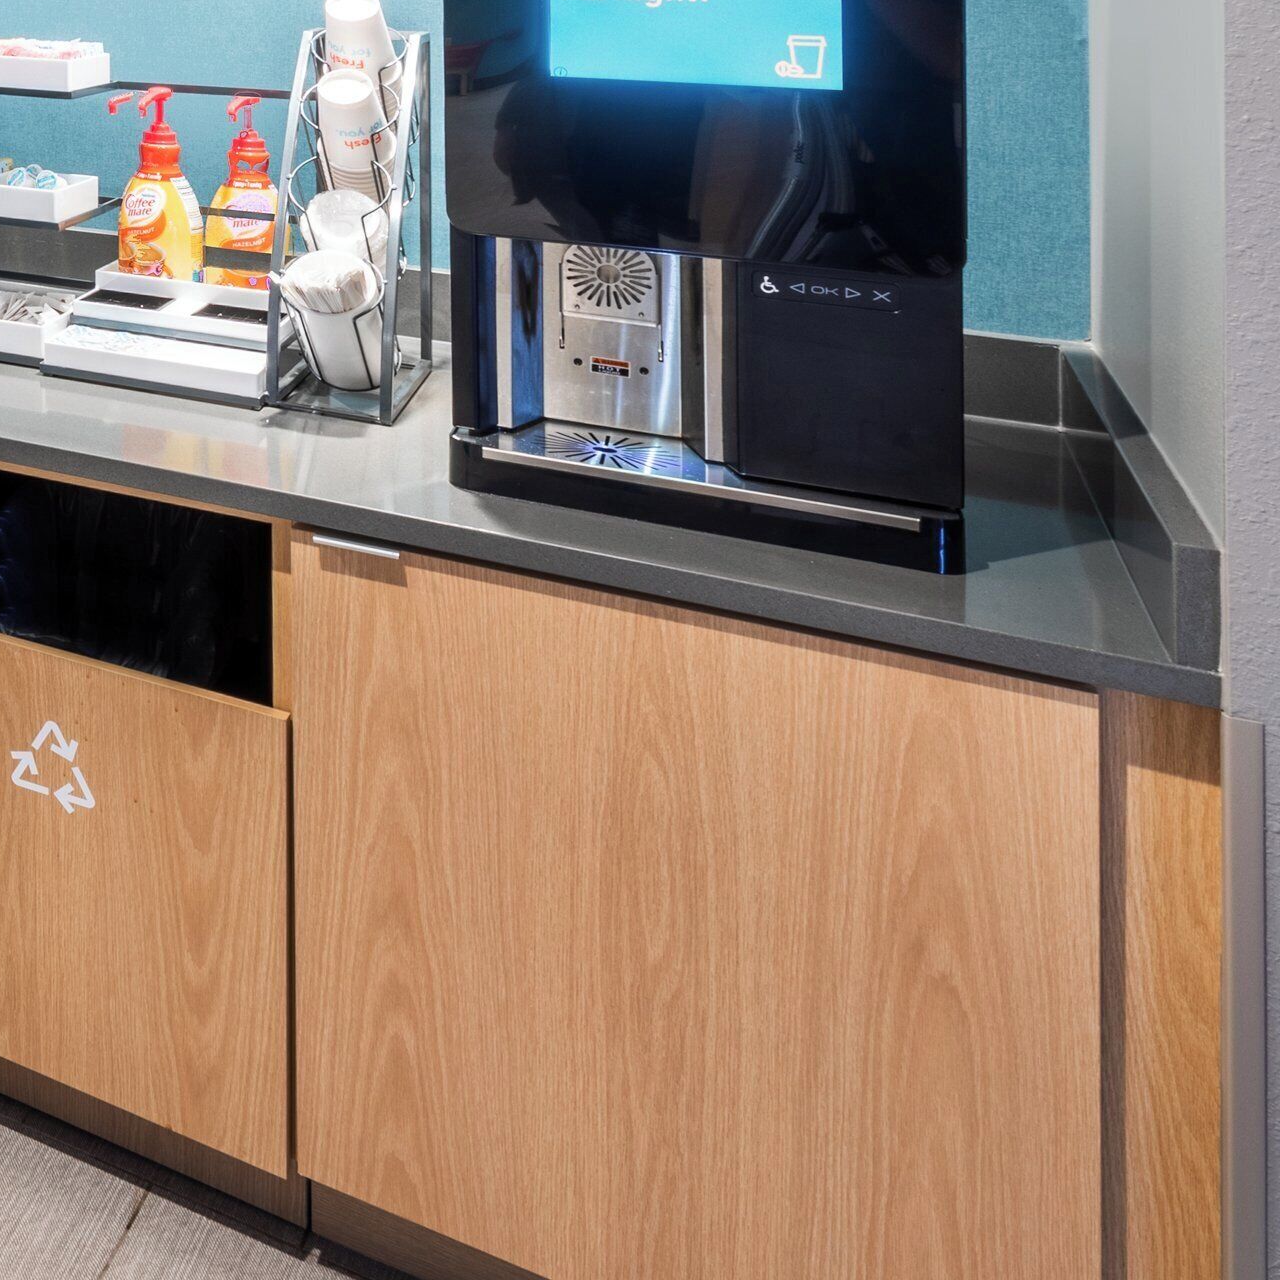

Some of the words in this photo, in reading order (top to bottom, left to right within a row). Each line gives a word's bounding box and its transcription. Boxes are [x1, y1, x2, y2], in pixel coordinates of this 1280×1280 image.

[330, 51, 365, 69] Fresh
[125, 193, 156, 210] Coffee
[127, 207, 152, 217] mate
[232, 237, 266, 248] HAZELNUT
[810, 285, 840, 297] OK
